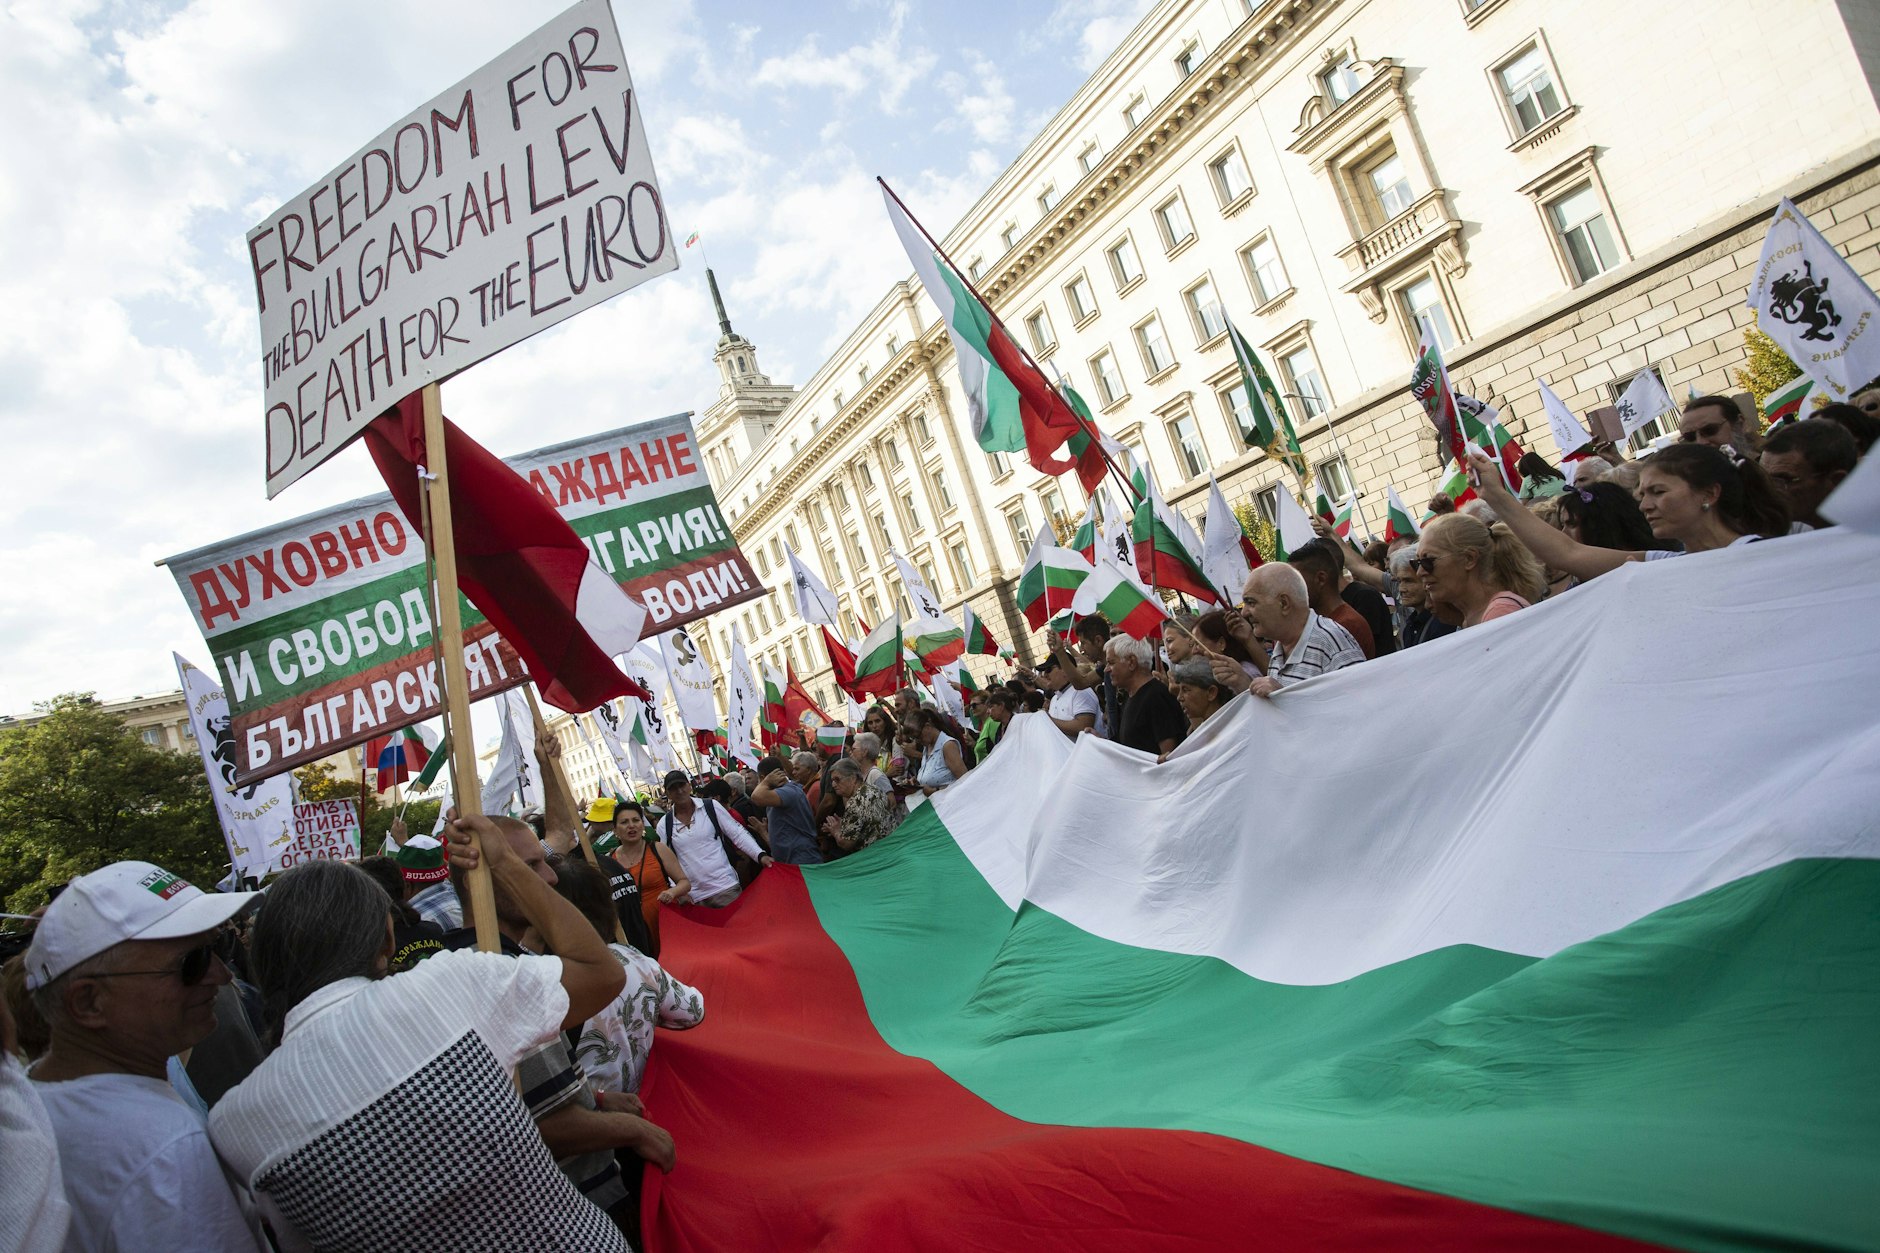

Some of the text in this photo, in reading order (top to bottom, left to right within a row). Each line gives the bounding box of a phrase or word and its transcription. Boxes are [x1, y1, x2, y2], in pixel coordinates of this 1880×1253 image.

[248, 27, 619, 314] FREEDOM FOR
[263, 332, 291, 390] THE
[526, 89, 632, 215] LEV
[265, 181, 667, 482] DEATH FOR THE EURO
[189, 511, 407, 630] ДУХОВНО
[224, 650, 263, 704] И
[268, 579, 441, 686] СВОБОД
[246, 558, 751, 770] БЪЛГАРСКЯТ ВОДИ!
[296, 813, 355, 835] ОТИВА
